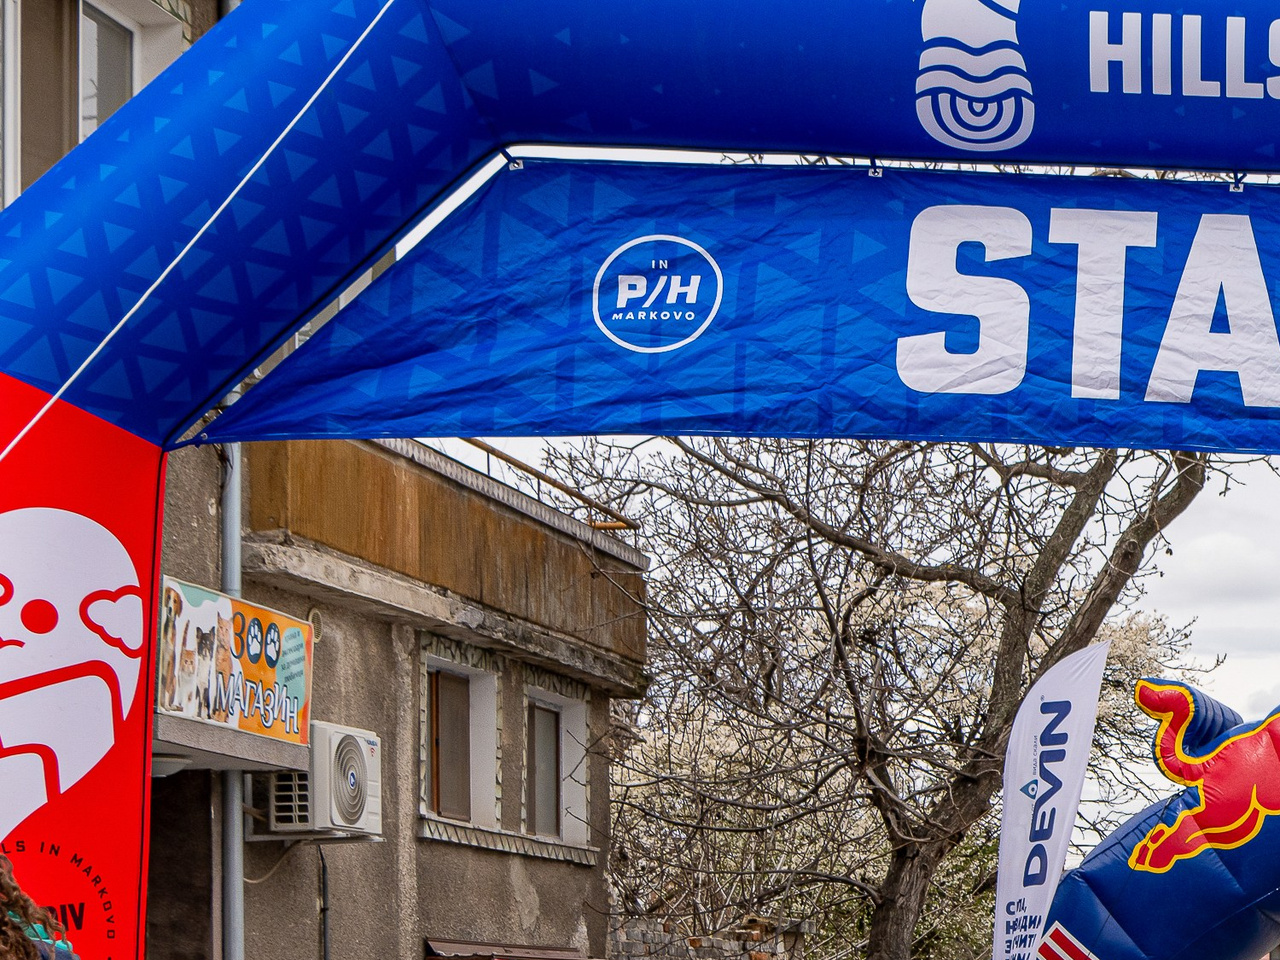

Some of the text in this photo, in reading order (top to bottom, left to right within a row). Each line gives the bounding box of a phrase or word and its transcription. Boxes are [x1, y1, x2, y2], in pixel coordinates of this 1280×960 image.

[651, 259, 669, 270] IN
[611, 311, 695, 321] MARKOVO
[616, 274, 702, 309] P/H
[214, 671, 299, 734] МАГАЗИН
[1023, 700, 1072, 888] DEVIN
[39, 841, 61, 857] IN
[70, 853, 116, 940] MARKOVO
